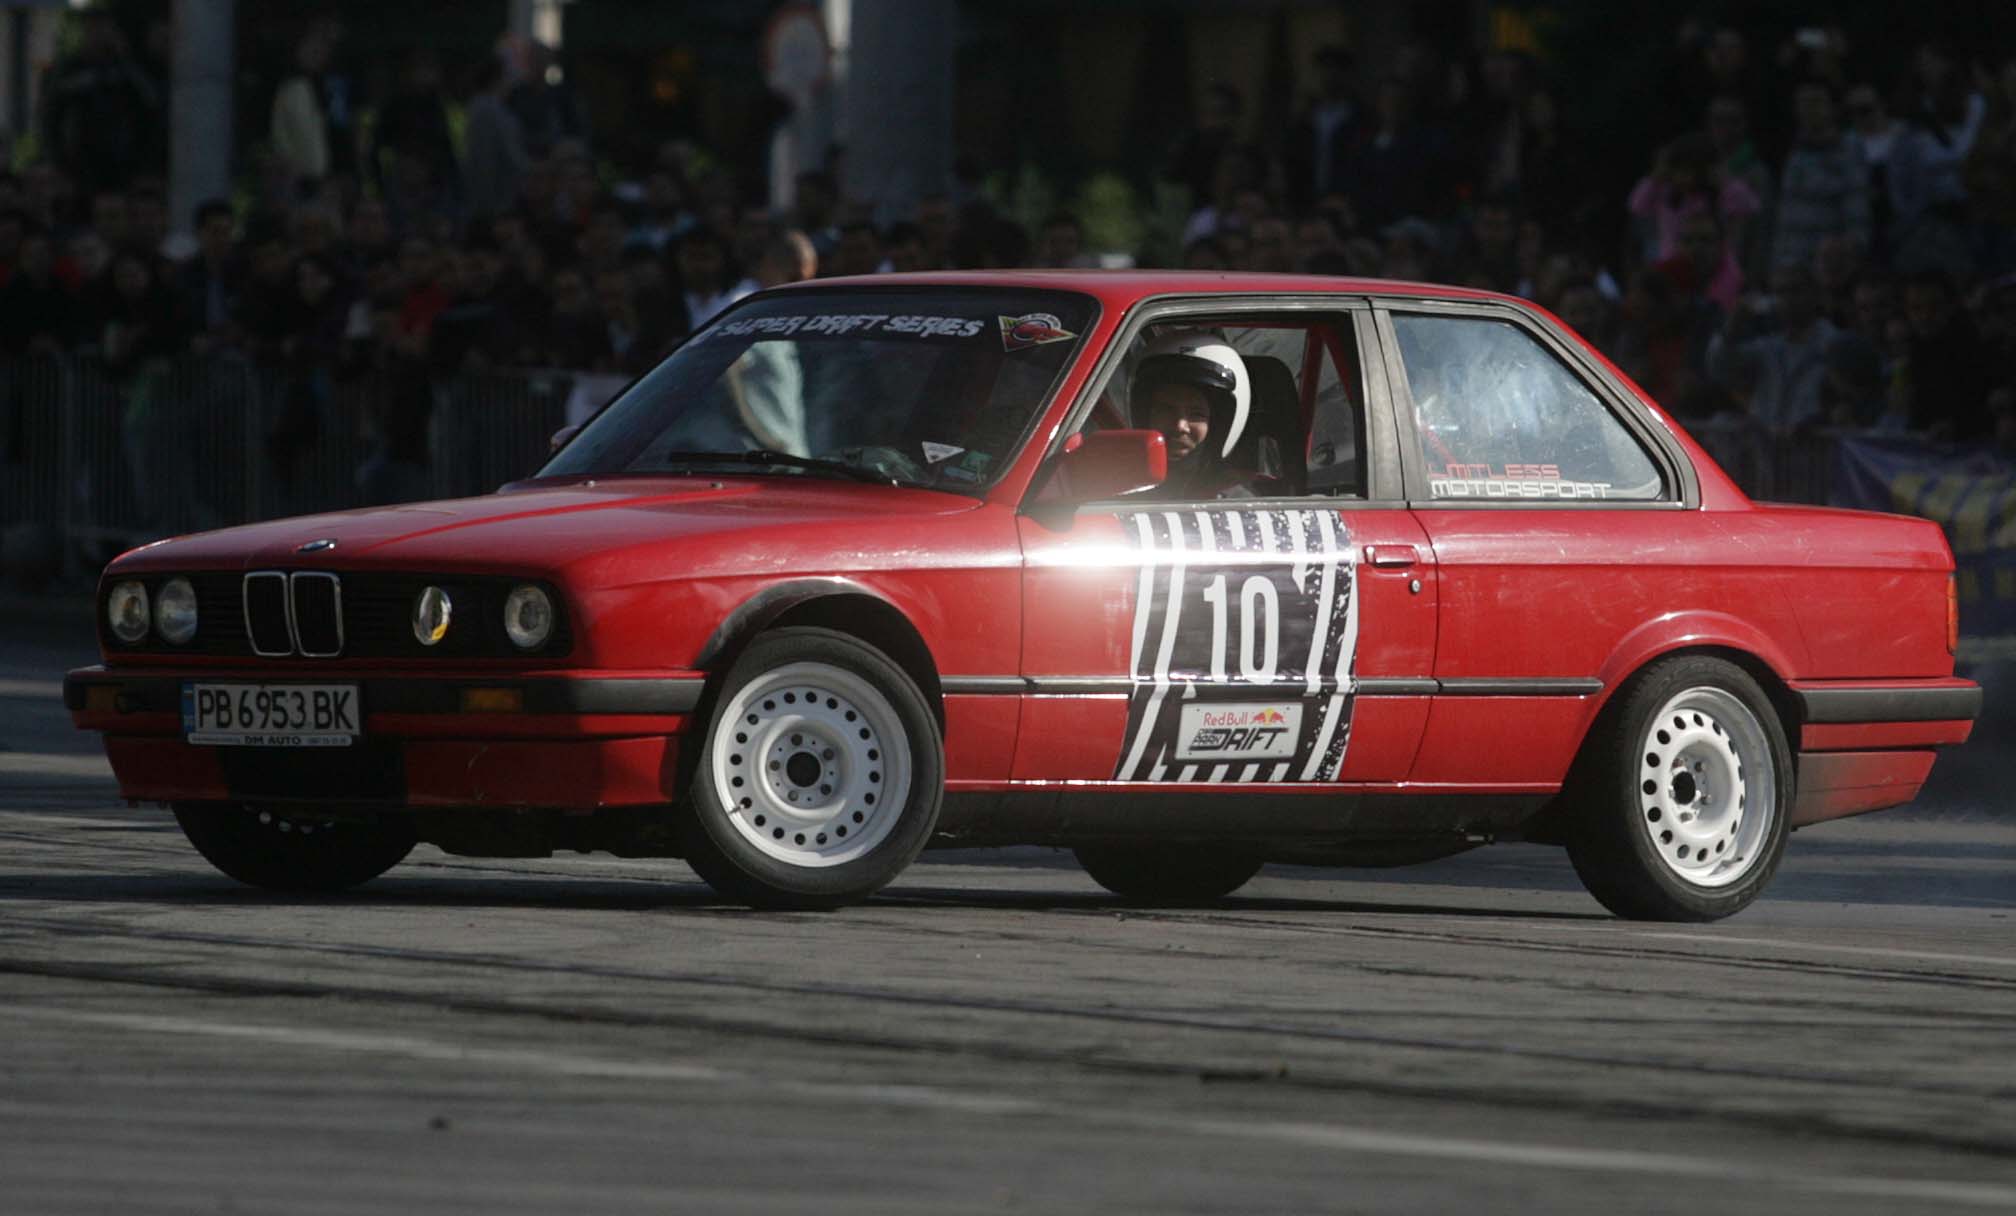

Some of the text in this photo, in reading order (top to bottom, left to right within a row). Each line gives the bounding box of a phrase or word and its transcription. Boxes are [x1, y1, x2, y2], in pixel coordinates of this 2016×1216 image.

[718, 315, 985, 338] SUPER DRIFT SERIES
[1431, 480, 1612, 499] MOTORSPORT
[1203, 574, 1280, 685] 10
[198, 689, 353, 730] PB 6953 BK
[1203, 711, 1249, 726] Red Bull
[267, 735, 302, 745] AUTO
[1188, 728, 1289, 751] DRIFT
